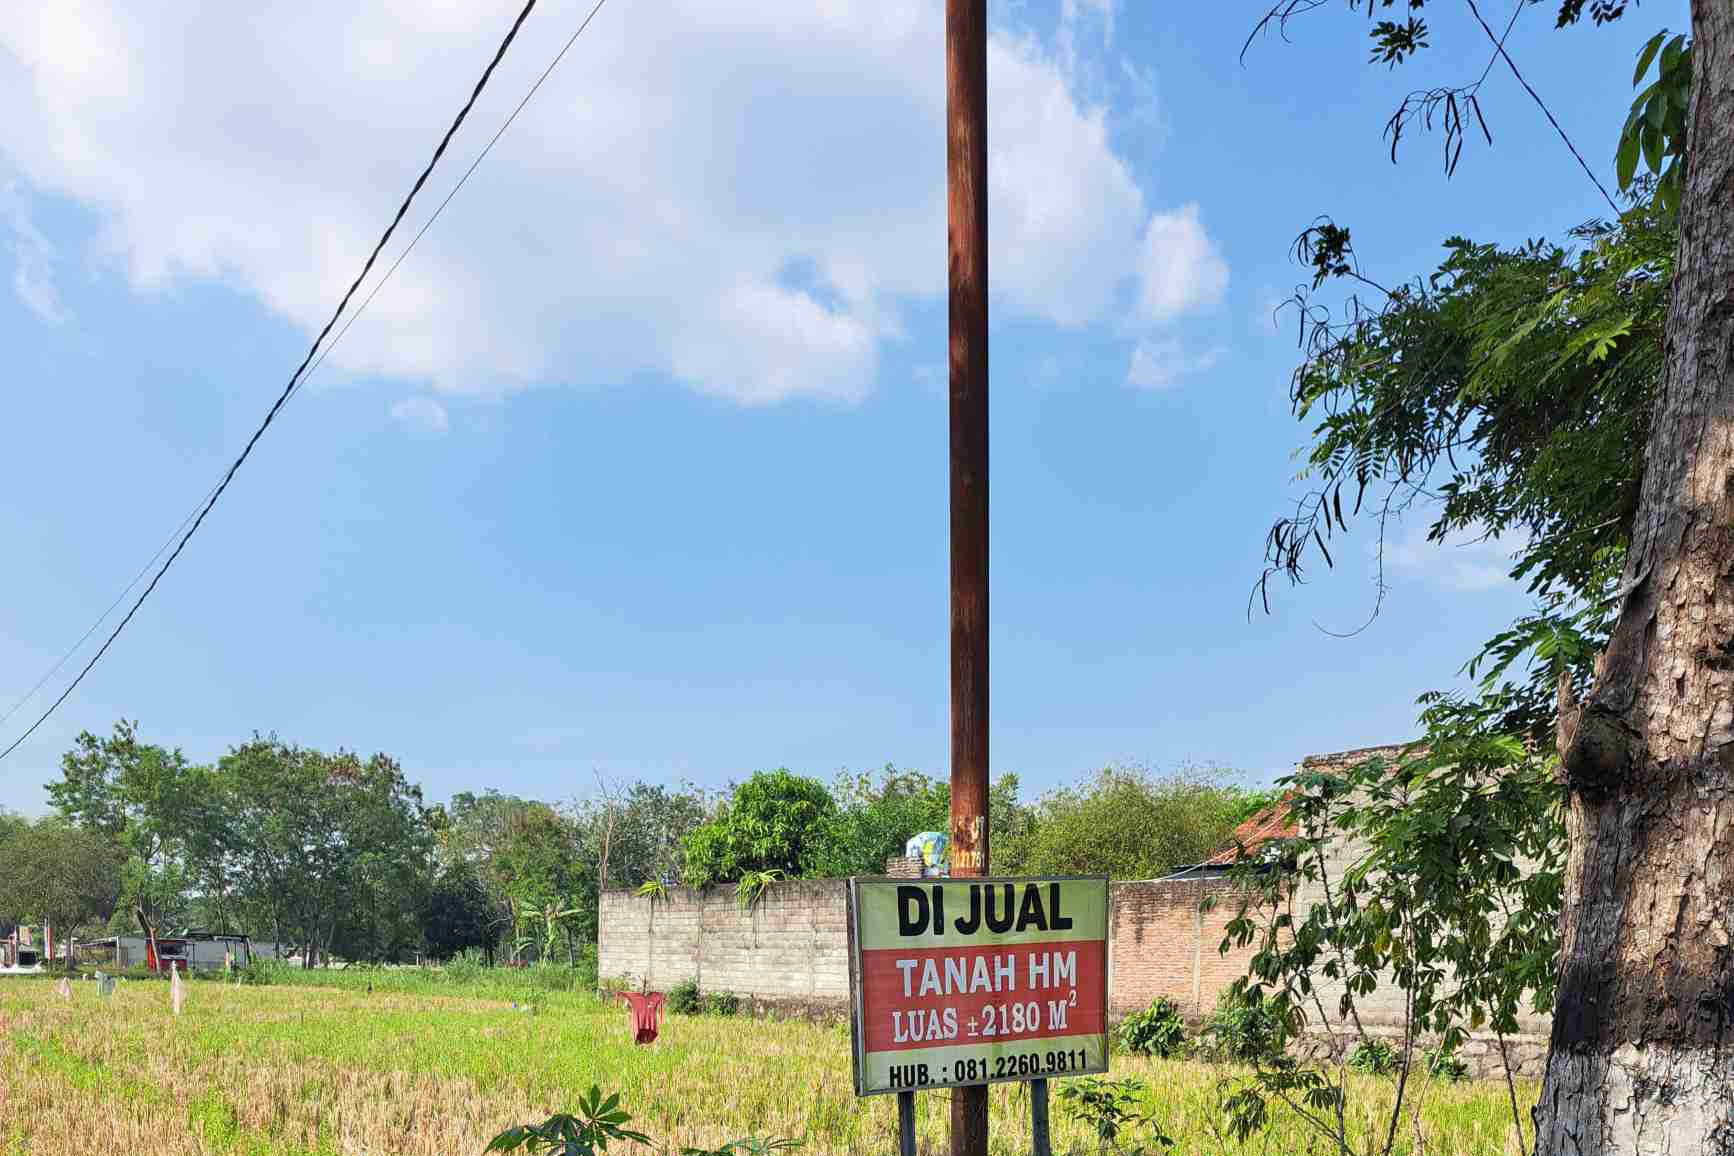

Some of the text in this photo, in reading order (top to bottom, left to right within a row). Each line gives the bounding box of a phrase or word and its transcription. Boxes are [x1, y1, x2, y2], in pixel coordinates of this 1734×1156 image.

[897, 883, 1073, 936] DI JUAL
[896, 951, 1077, 997] TANAH HM
[892, 1007, 958, 1042] LUAS
[954, 1048, 1088, 1082] 081.2260.9811
